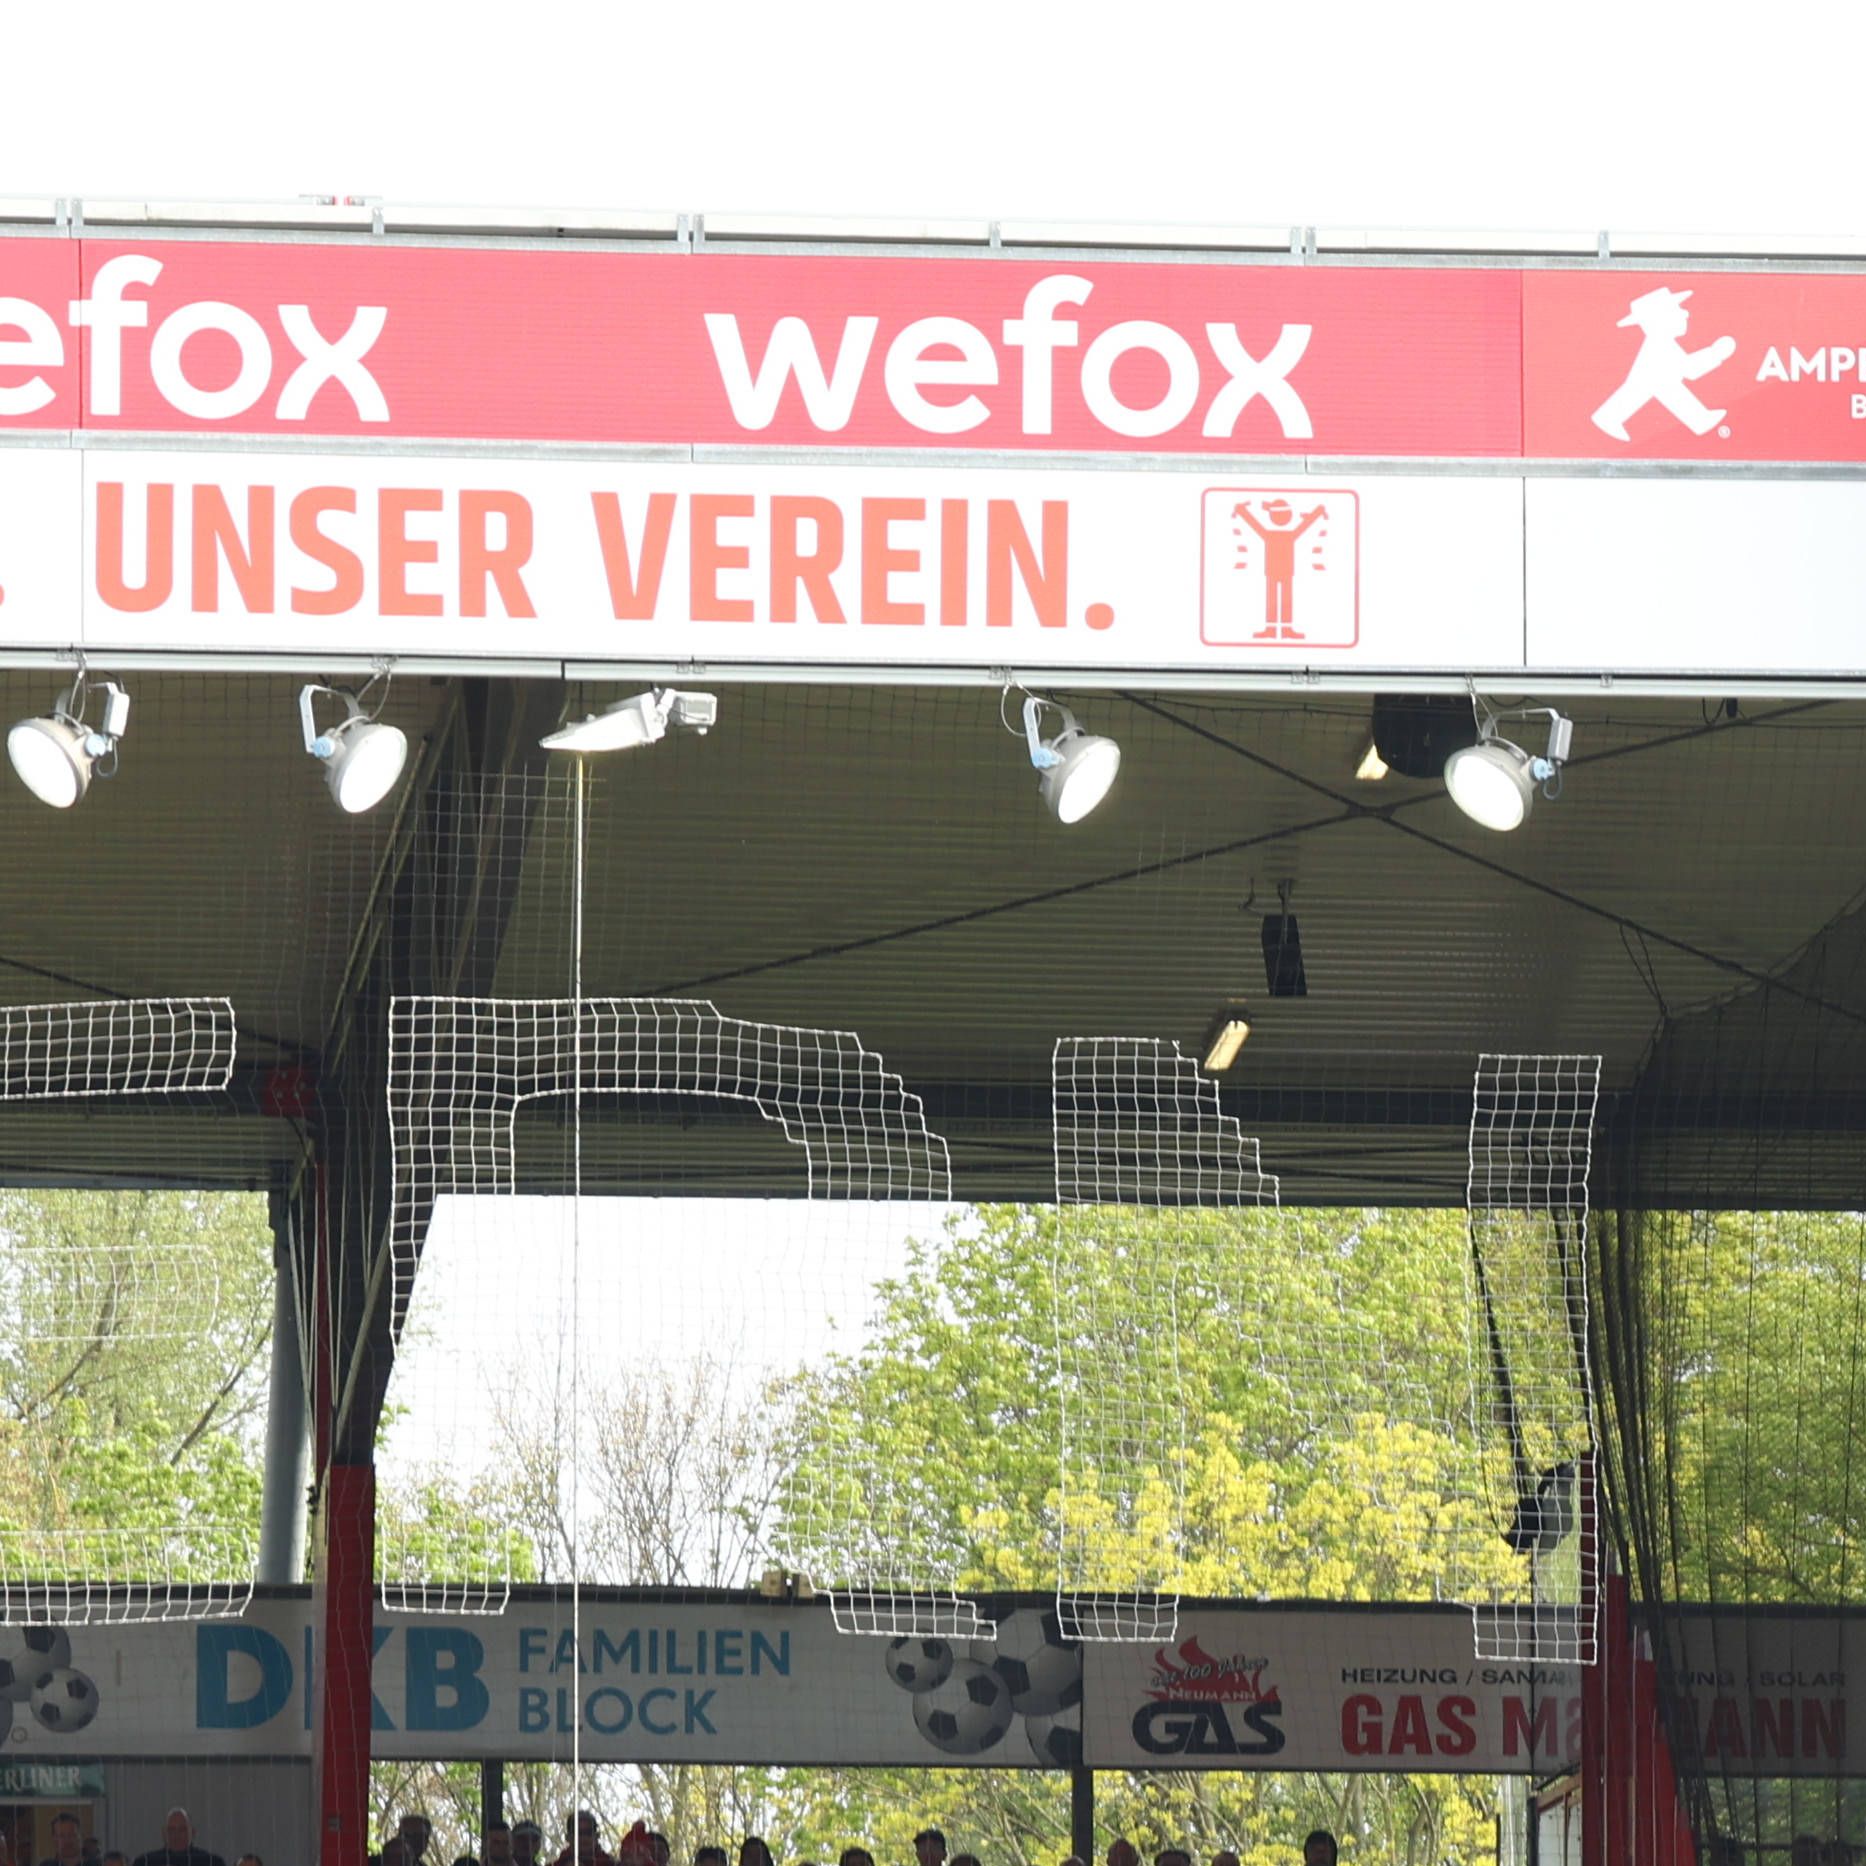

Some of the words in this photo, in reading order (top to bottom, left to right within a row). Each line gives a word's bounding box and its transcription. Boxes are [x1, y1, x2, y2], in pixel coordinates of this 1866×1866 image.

[704, 274, 1313, 439] wefox
[94, 480, 539, 620] UNSER
[591, 491, 1116, 631] VEREIN.
[519, 1628, 792, 1676] FAMILIEN
[1341, 1668, 1458, 1685] HEIZUNG
[518, 1687, 718, 1735] BLOCK
[1131, 1699, 1287, 1756] GAS
[1340, 1693, 1477, 1757] GAS
